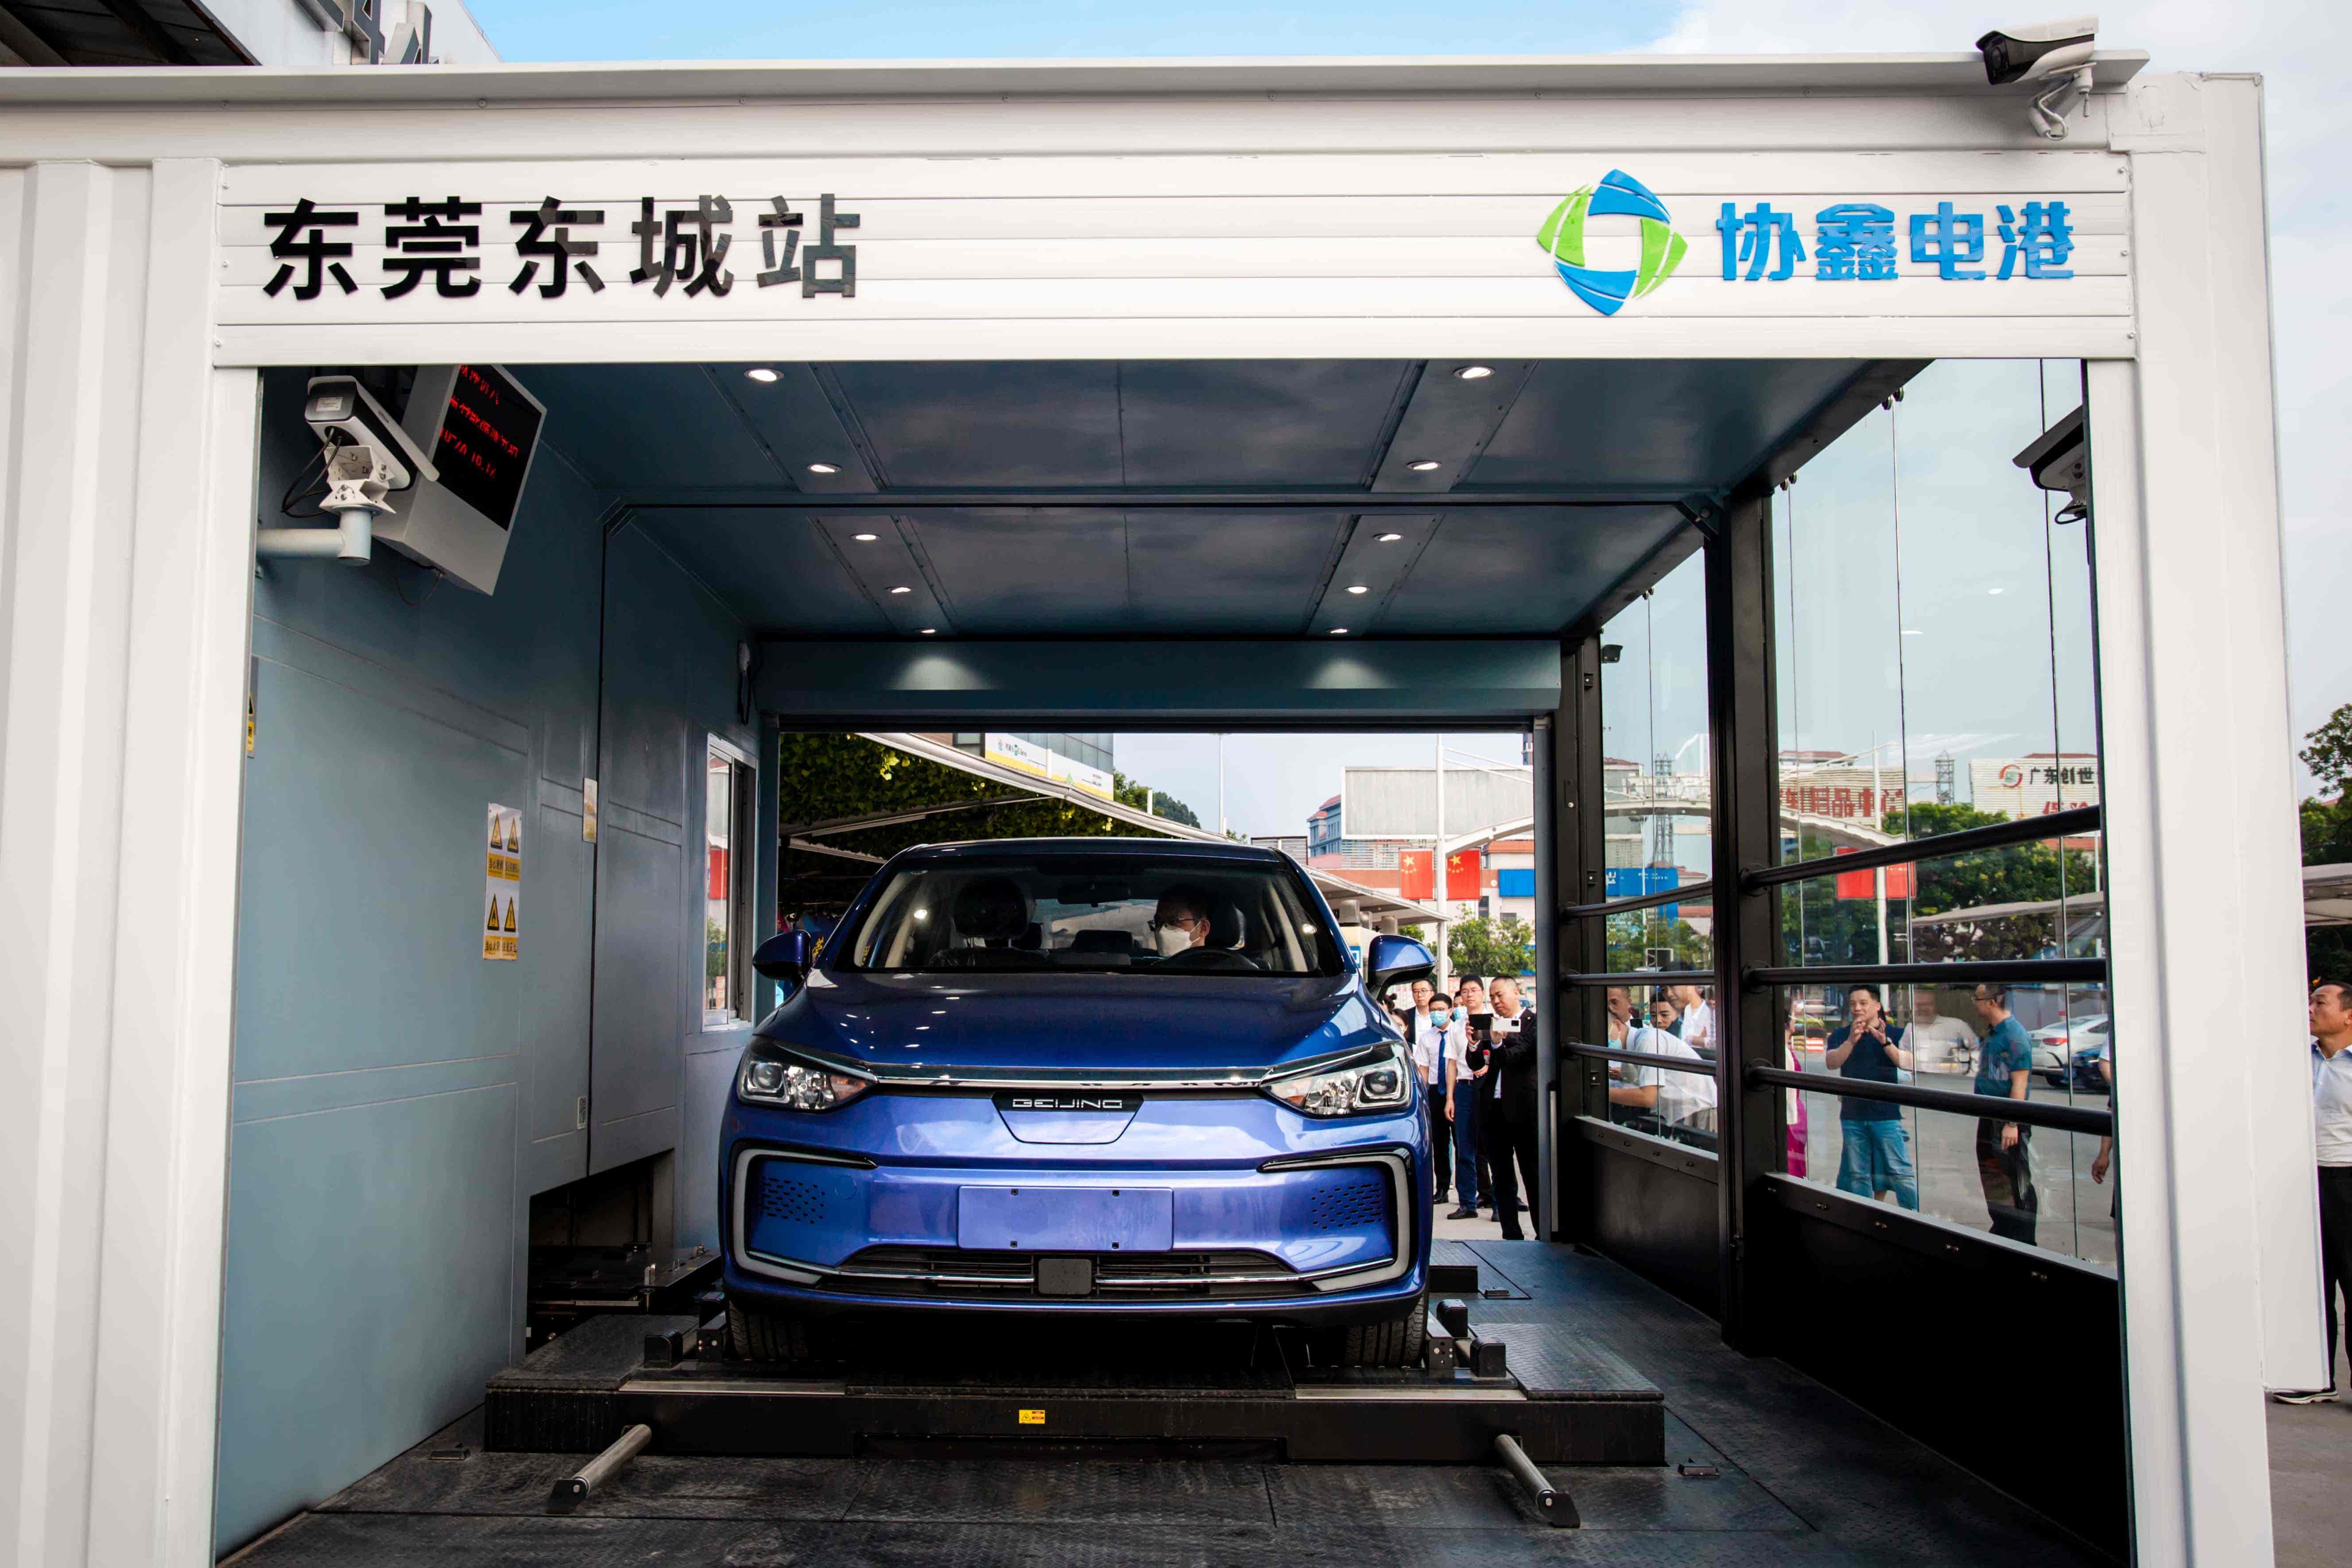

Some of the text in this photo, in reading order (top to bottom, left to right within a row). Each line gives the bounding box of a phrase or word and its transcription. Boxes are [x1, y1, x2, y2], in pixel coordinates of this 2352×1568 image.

[263, 194, 861, 300] 东莞东城站
[1716, 201, 2074, 281] 协鑫电港
[1012, 1098, 1123, 1109] BEIJING
